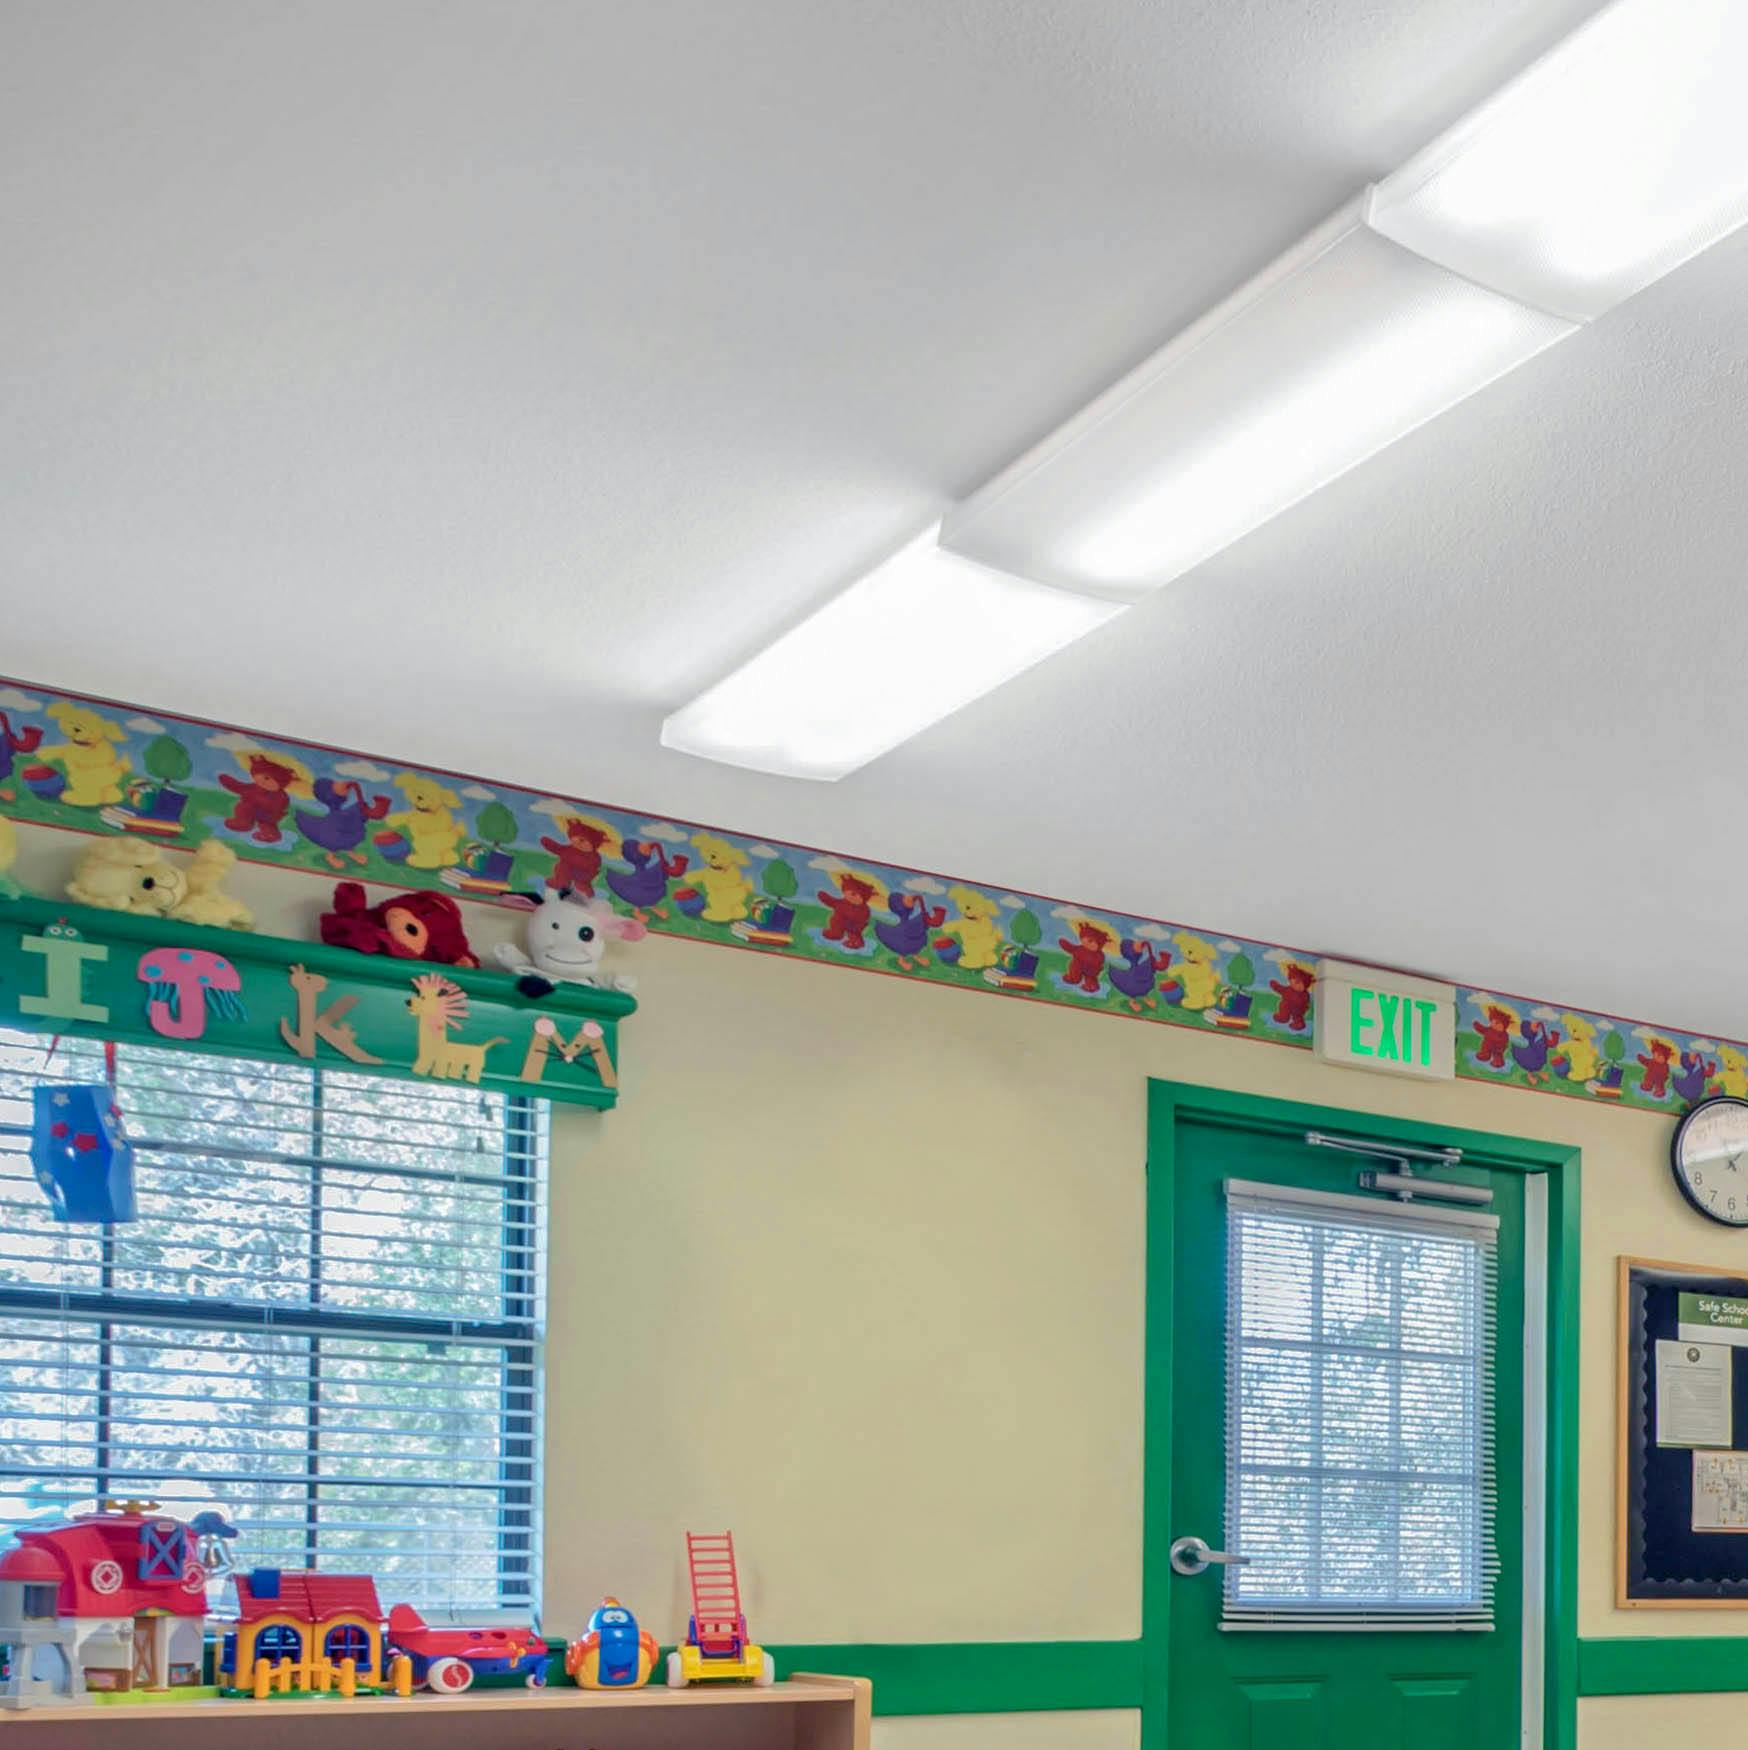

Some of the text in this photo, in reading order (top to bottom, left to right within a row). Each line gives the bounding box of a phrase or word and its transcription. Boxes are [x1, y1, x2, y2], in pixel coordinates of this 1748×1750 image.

[1350, 987, 1437, 1067] EXIT
[1693, 1170, 1704, 1186] 8
[1708, 1189, 1719, 1203] 7
[1727, 1197, 1737, 1212] 6
[1698, 1300, 1721, 1313] Safe
[1710, 1313, 1744, 1325] Center
